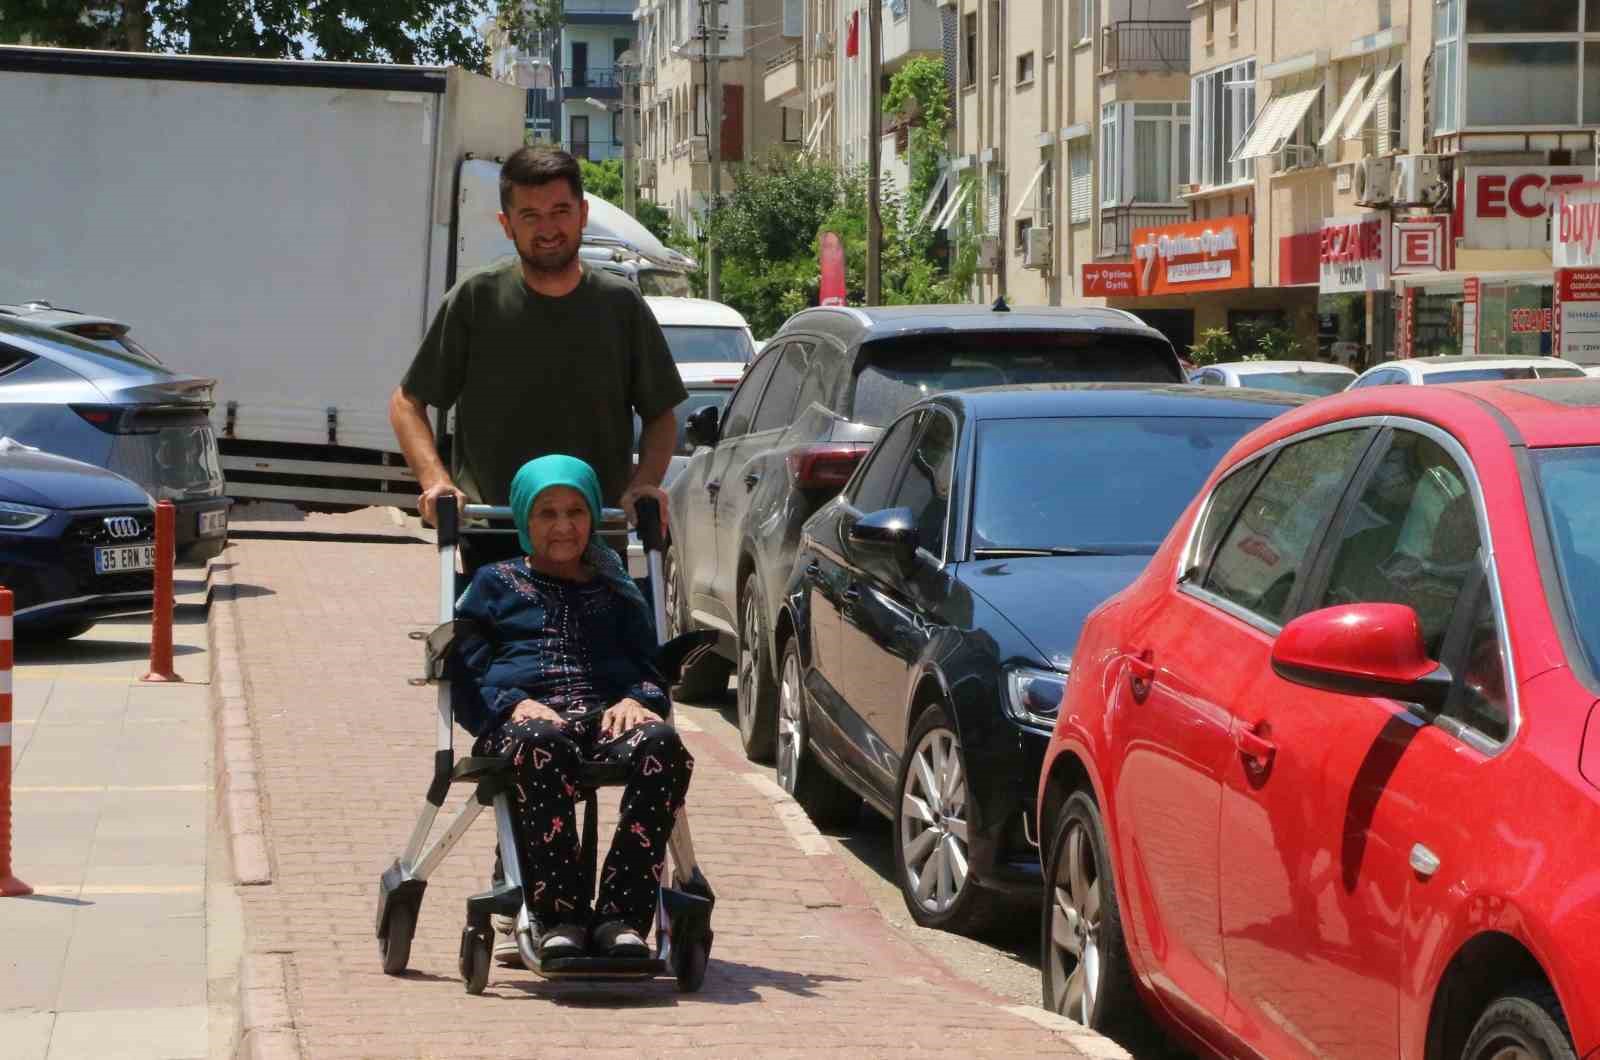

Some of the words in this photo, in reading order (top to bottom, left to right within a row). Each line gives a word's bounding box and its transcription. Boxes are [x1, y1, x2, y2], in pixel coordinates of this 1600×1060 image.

[1560, 192, 1600, 256] buy
[1407, 234, 1429, 262] E
[103, 550, 116, 570] 35
